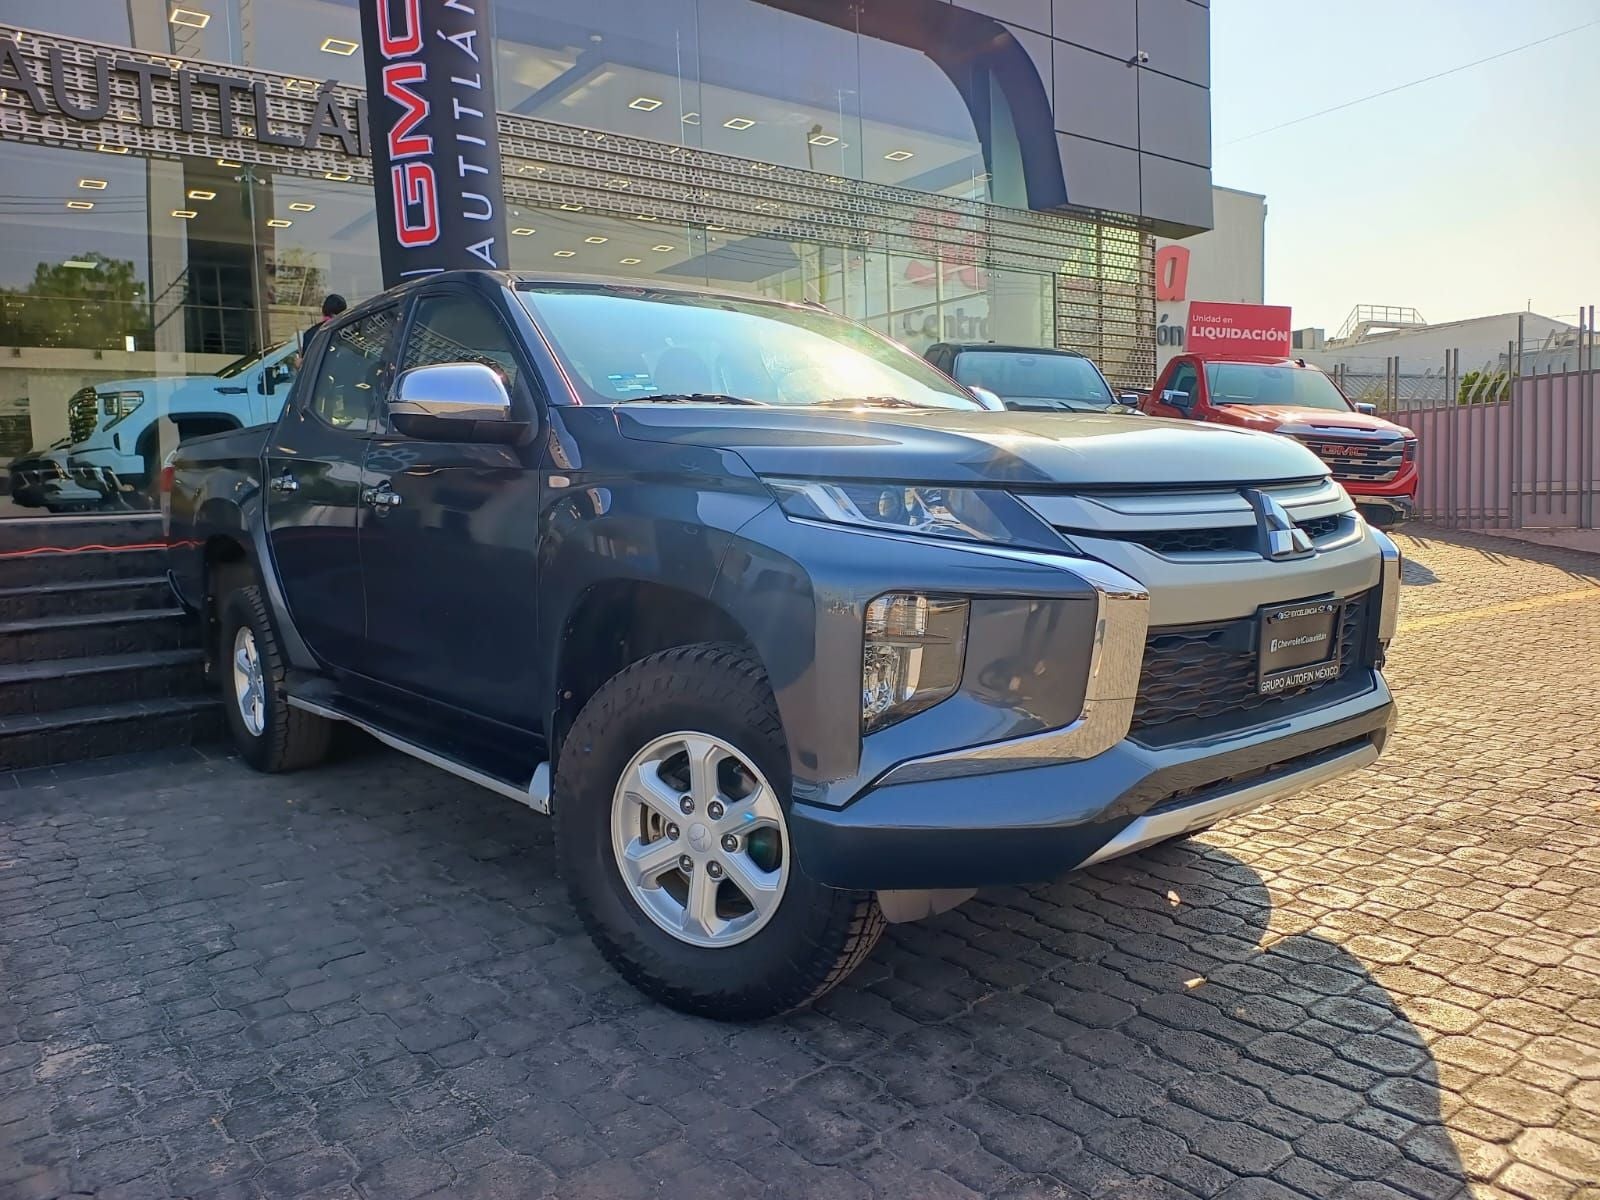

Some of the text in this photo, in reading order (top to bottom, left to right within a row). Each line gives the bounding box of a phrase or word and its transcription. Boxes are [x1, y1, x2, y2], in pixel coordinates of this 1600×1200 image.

[376, 0, 440, 248] GMC
[1192, 314, 1220, 324] Unidad
[1191, 326, 1288, 342] LIQUIDACIÓN
[1321, 444, 1368, 457] GMC
[1261, 678, 1285, 692] GRUPO
[1286, 671, 1314, 686] AUTOFIN
